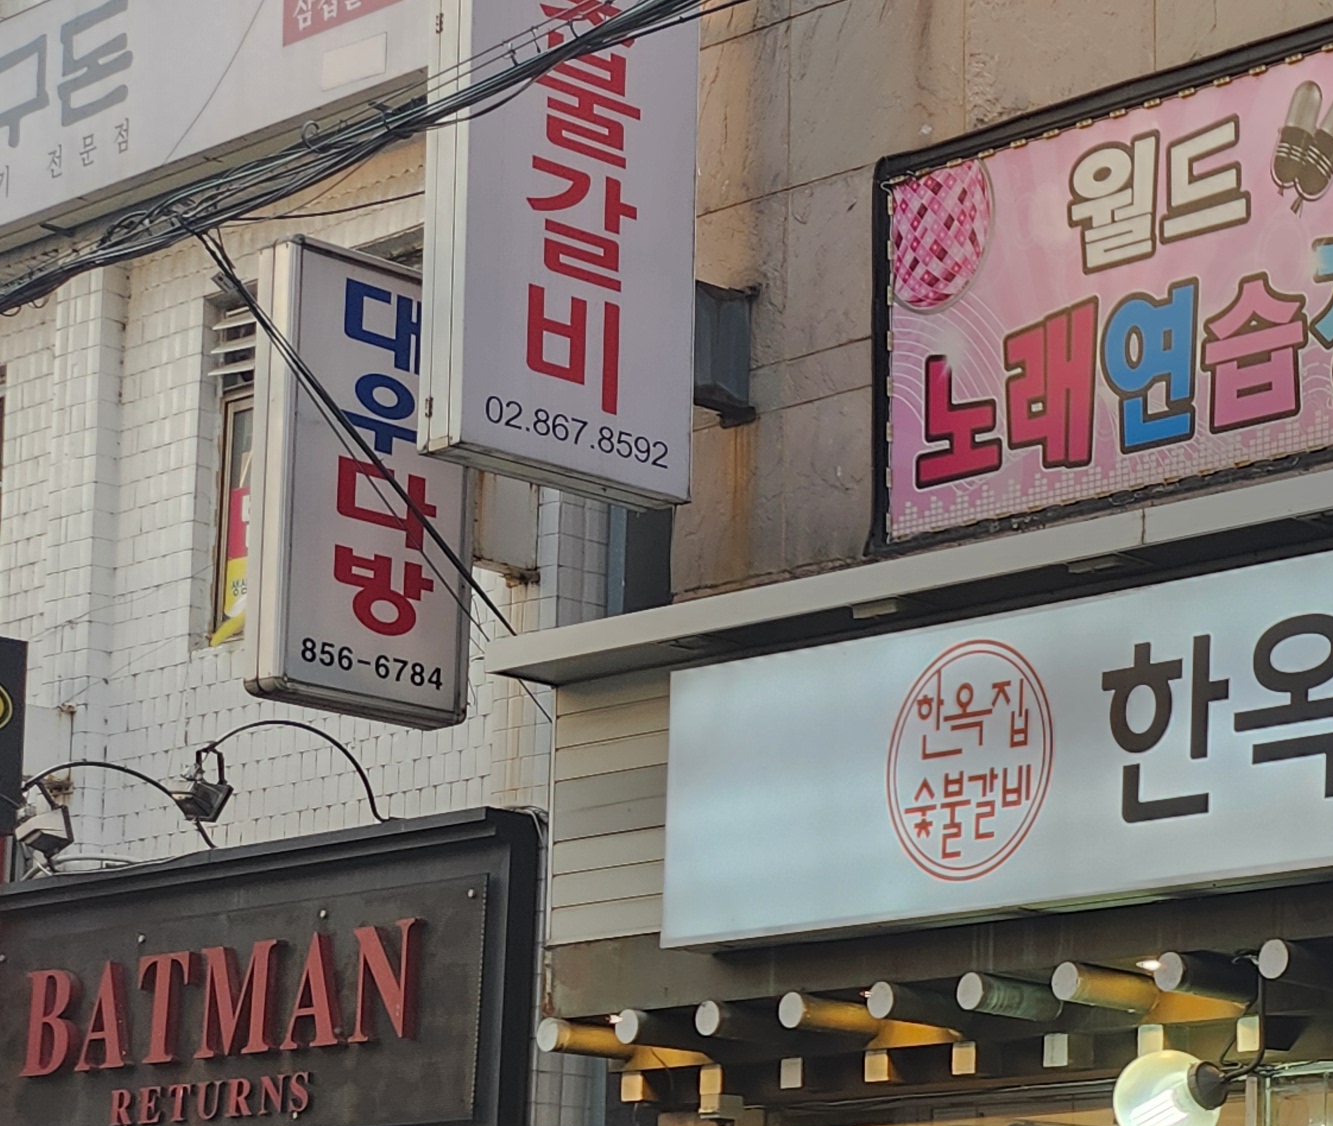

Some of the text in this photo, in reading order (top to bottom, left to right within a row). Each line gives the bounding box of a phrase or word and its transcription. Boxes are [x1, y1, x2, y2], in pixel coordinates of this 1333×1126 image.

[47, 117, 131, 180] 전문점
[1068, 114, 1251, 274] 월드
[526, 0, 641, 414] 불갈비
[484, 394, 670, 470] 02.867.8592
[300, 637, 445, 692] 856-6784
[914, 671, 1032, 762] 한옥집
[904, 763, 1032, 860] 숯불갈비
[20, 917, 424, 1078] BATMAN
